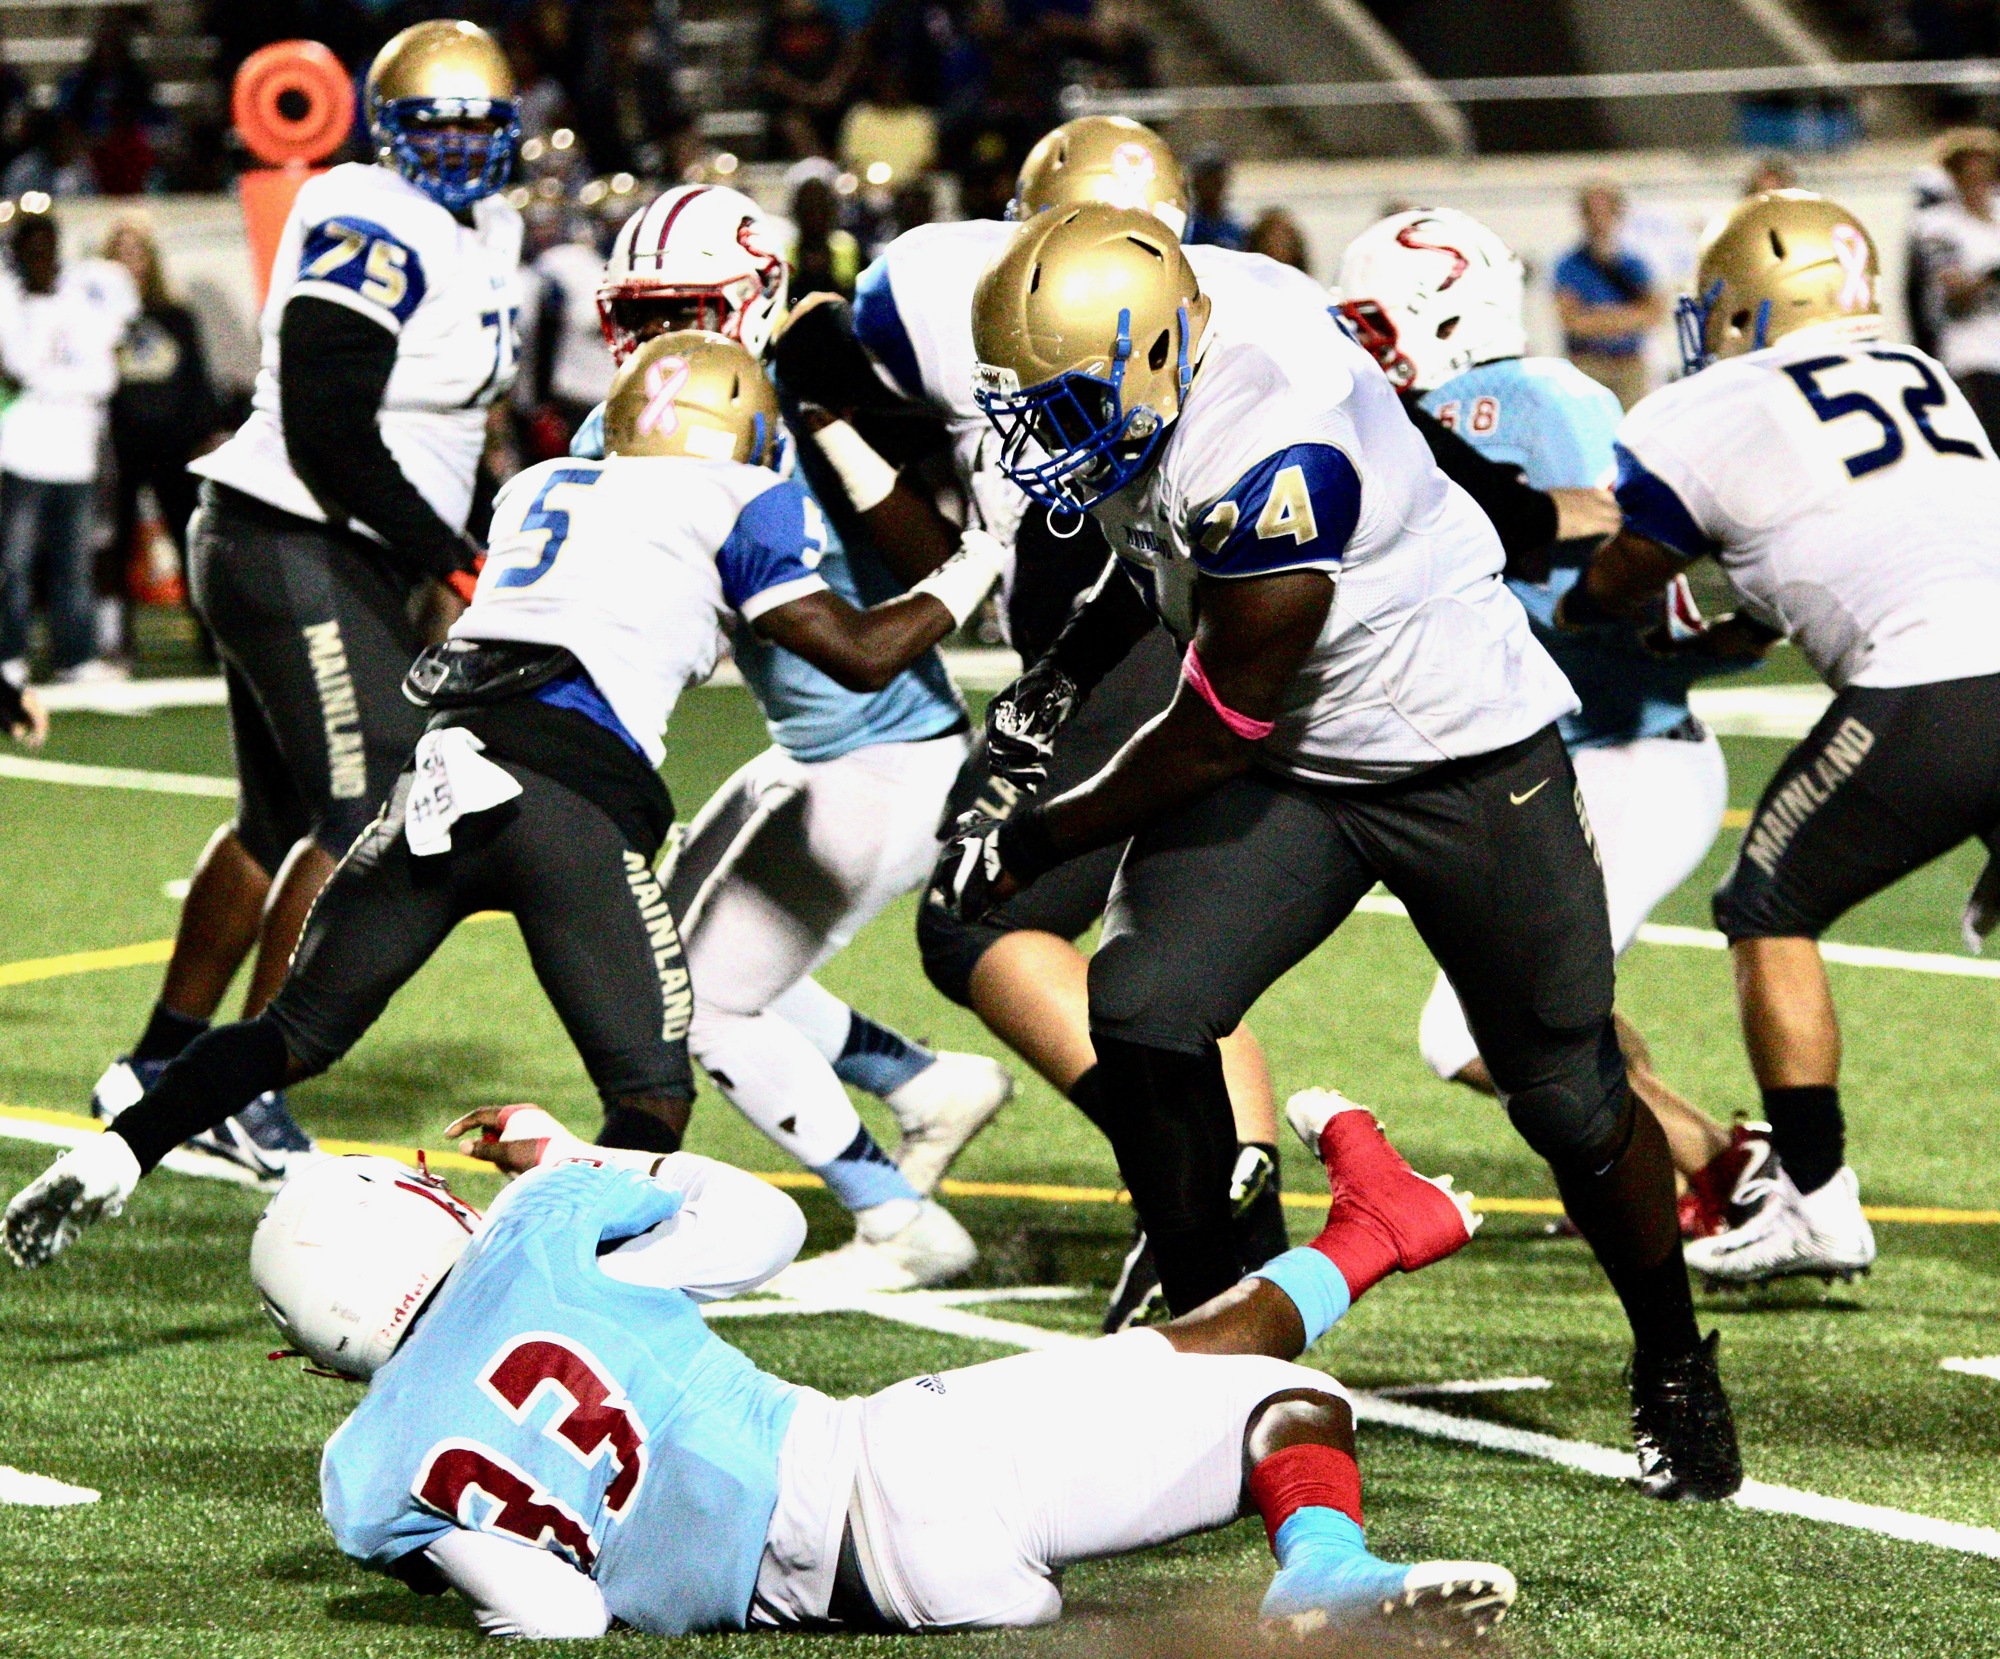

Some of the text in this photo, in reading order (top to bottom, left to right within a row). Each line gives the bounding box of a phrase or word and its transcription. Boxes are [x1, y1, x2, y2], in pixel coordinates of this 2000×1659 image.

[323, 220, 408, 309] 75
[1778, 349, 1986, 481] 52
[492, 467, 606, 592] 5
[302, 618, 368, 800] MAINLAND
[1746, 716, 1876, 878] MAINLAND
[622, 848, 695, 1044] MAINLAND
[410, 1330, 650, 1579] 33
